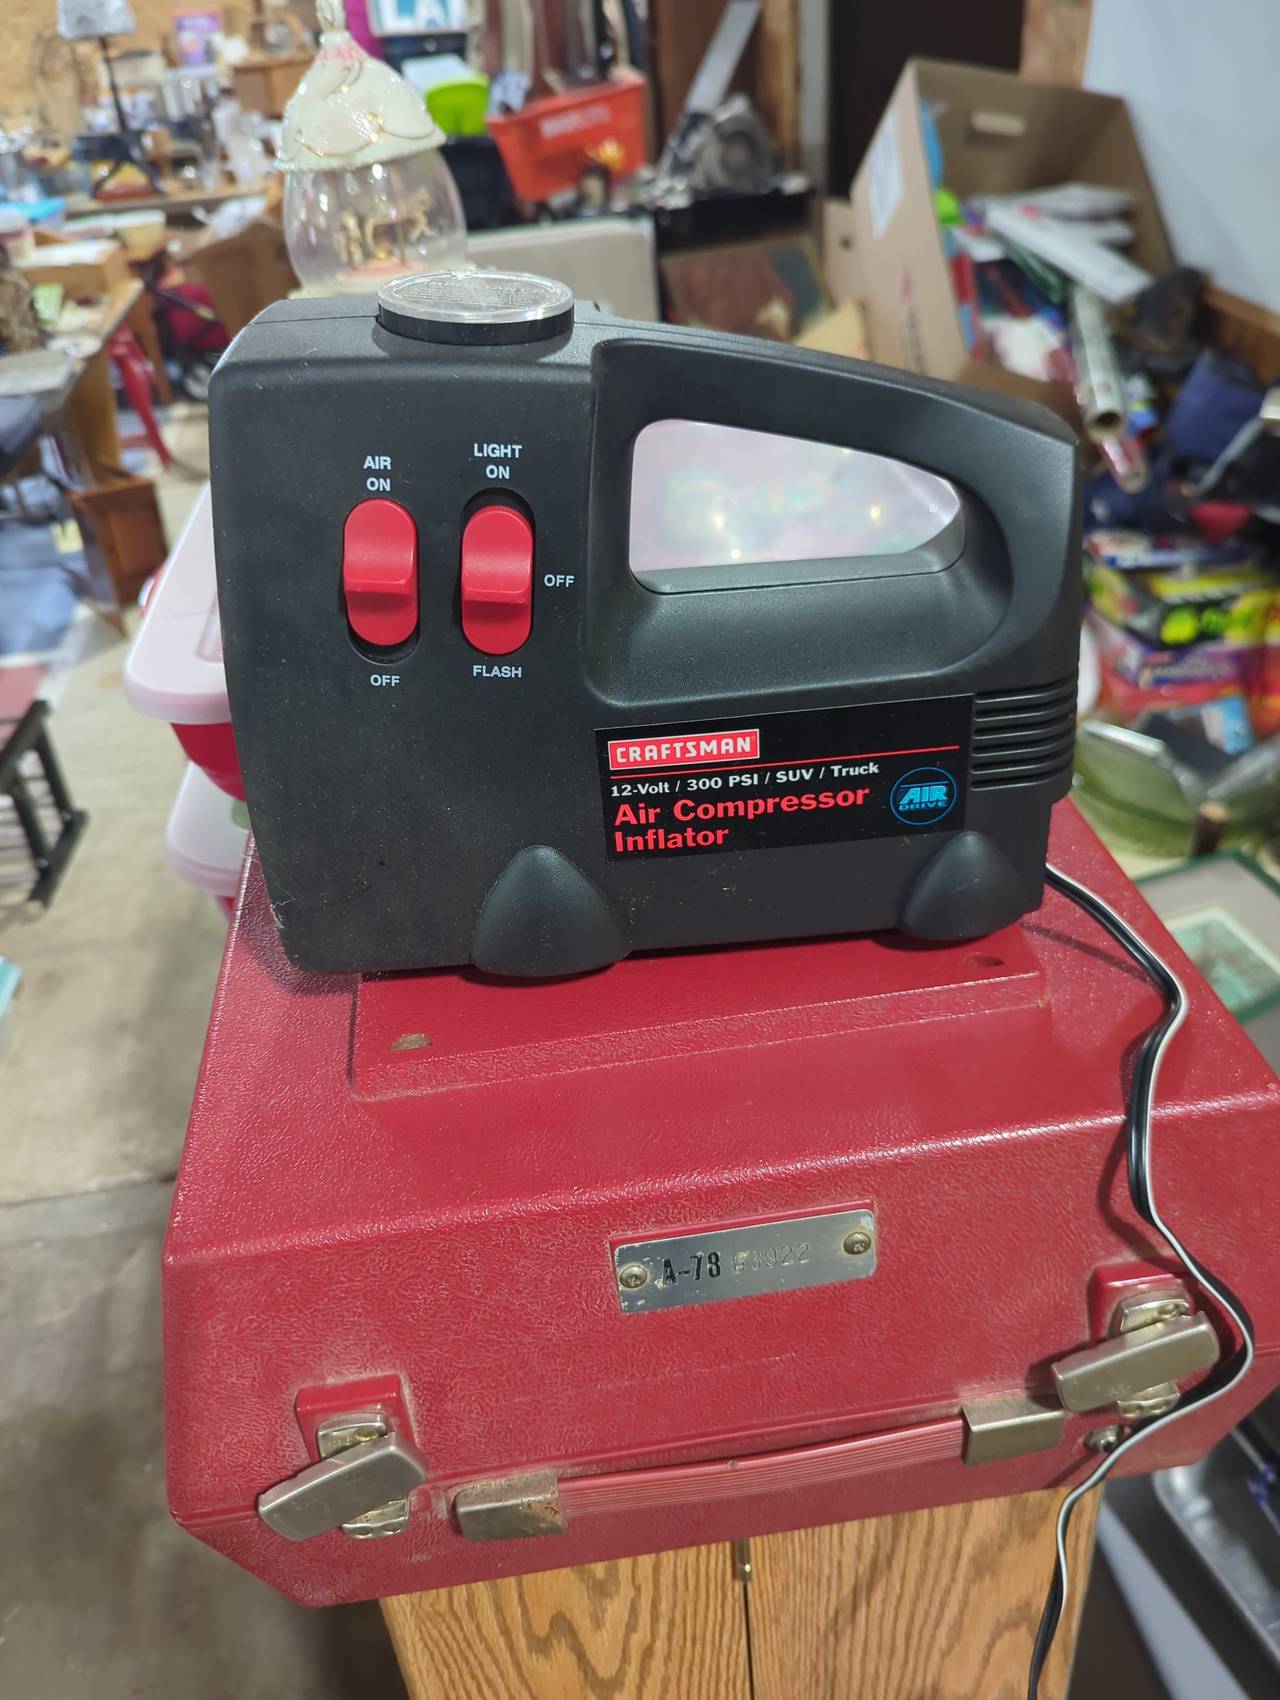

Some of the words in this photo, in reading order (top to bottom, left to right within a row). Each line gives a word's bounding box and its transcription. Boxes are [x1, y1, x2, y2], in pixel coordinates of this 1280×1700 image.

[474, 443, 523, 458] LIGHT
[363, 456, 392, 470] AIR
[486, 465, 510, 480] ON
[366, 478, 391, 492] ON
[544, 574, 575, 588] OFF
[472, 664, 522, 679] FLASH
[370, 674, 400, 687] OFF
[616, 736, 751, 764] CRAFTSMAN
[611, 783, 670, 797] 12-Volt
[687, 778, 722, 791] 300
[728, 774, 759, 787] PSI
[775, 768, 815, 783] SUV
[831, 762, 880, 777] Truck
[899, 785, 947, 804] AIR
[614, 803, 661, 826] Air
[673, 785, 870, 822] Compressor
[898, 800, 947, 811] DRIVE
[614, 826, 729, 853] Inflator
[661, 1251, 721, 1285] A-78
